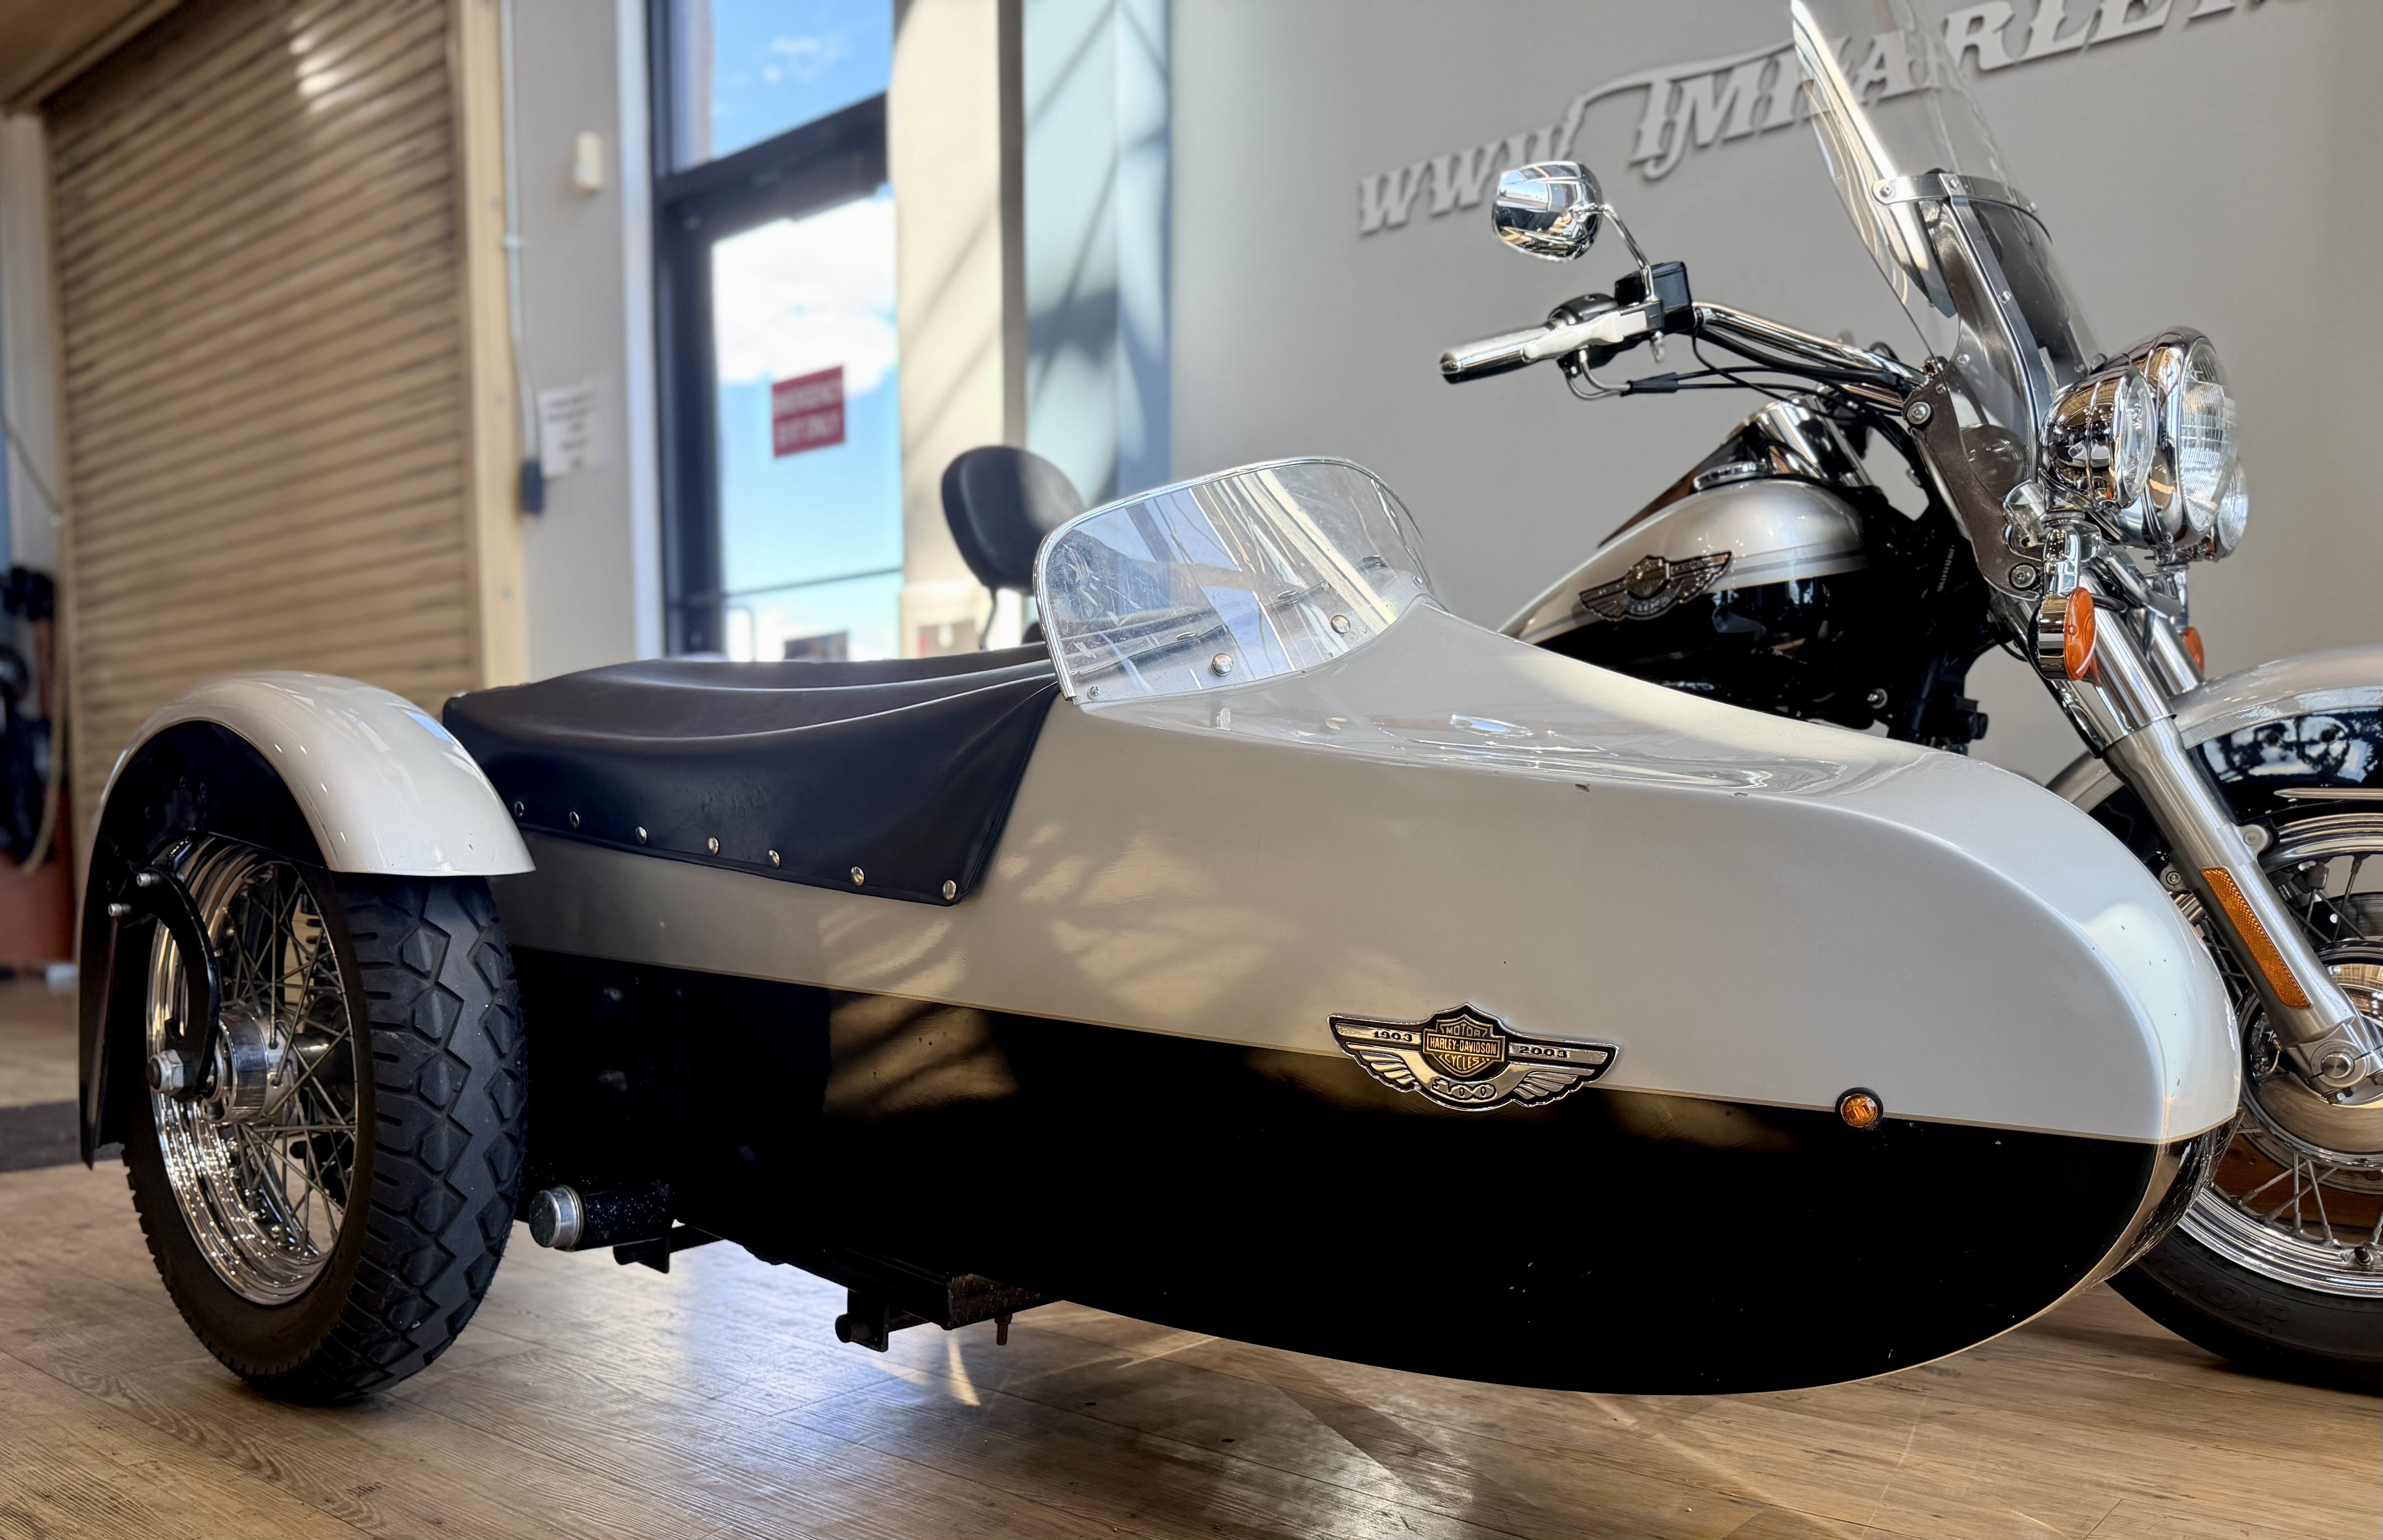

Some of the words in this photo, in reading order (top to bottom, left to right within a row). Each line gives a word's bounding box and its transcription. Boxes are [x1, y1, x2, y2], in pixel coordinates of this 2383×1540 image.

[1373, 1031, 1412, 1042] 1903
[1446, 1023, 1480, 1037] MOTOR
[1430, 1037, 1497, 1055] HARLEY-DAVIDSON
[1519, 1045, 1568, 1058] 2003
[1445, 1054, 1480, 1070] CYCLES
